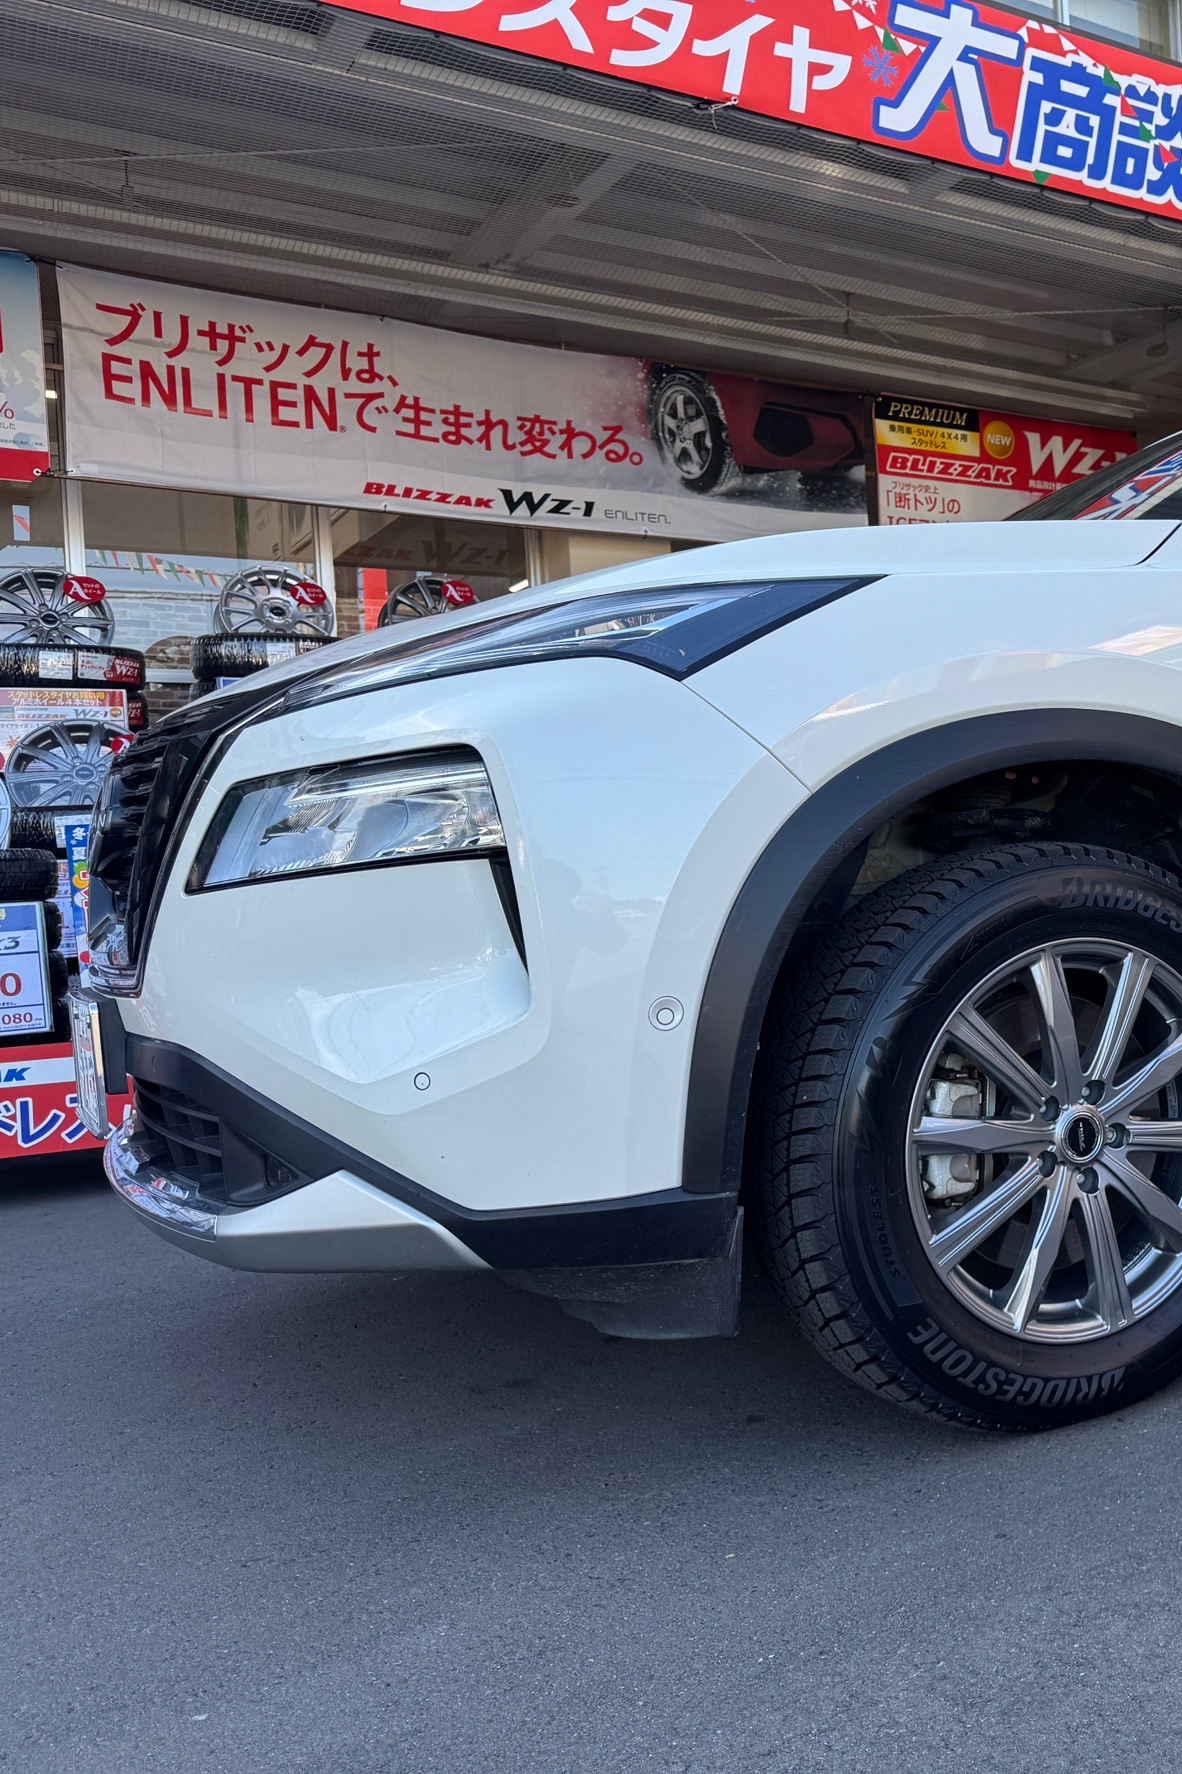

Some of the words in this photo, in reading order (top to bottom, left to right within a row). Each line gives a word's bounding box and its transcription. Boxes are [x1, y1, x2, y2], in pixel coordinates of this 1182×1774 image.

[95, 302, 399, 387] ブリザックは、
[888, 402, 968, 426] PREMIUM
[911, 437, 948, 450] スタッドレス
[986, 433, 1012, 447] NEW
[886, 452, 1017, 486] BLIZZAK
[363, 481, 496, 509] BLIZZAK
[497, 487, 596, 517] WZ-1
[886, 489, 962, 515] 「断トツ」の
[115, 664, 139, 677] WZ-1
[73, 708, 109, 718] WZ-1
[906, 1317, 1127, 1408] BRIDGESTONE
